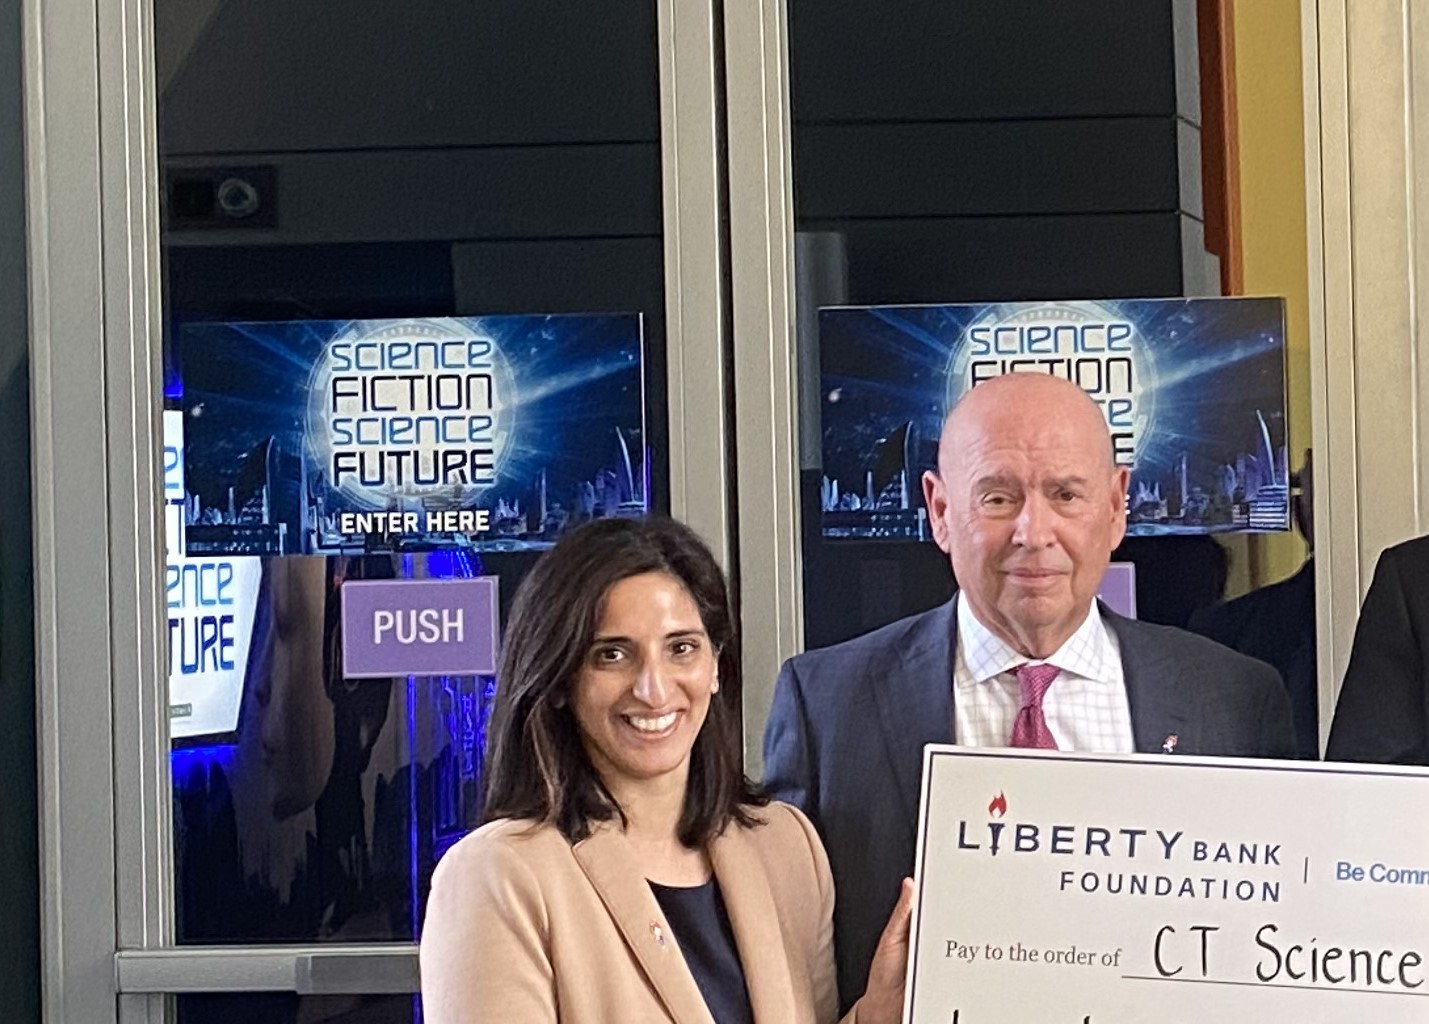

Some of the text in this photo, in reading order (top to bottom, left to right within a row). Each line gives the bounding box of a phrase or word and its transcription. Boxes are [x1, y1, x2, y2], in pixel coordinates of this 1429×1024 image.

[333, 449, 494, 487] FUTURE
[341, 510, 490, 534] ENTER HERE
[374, 609, 464, 644] PUSH
[958, 819, 1282, 866] LIBERTY BANK
[1060, 871, 1281, 902] FOUNDATION
[1336, 861, 1365, 882] Be
[945, 940, 1123, 967] Pay to the order of
[1154, 925, 1220, 977] CT
[1255, 924, 1425, 988] Science
